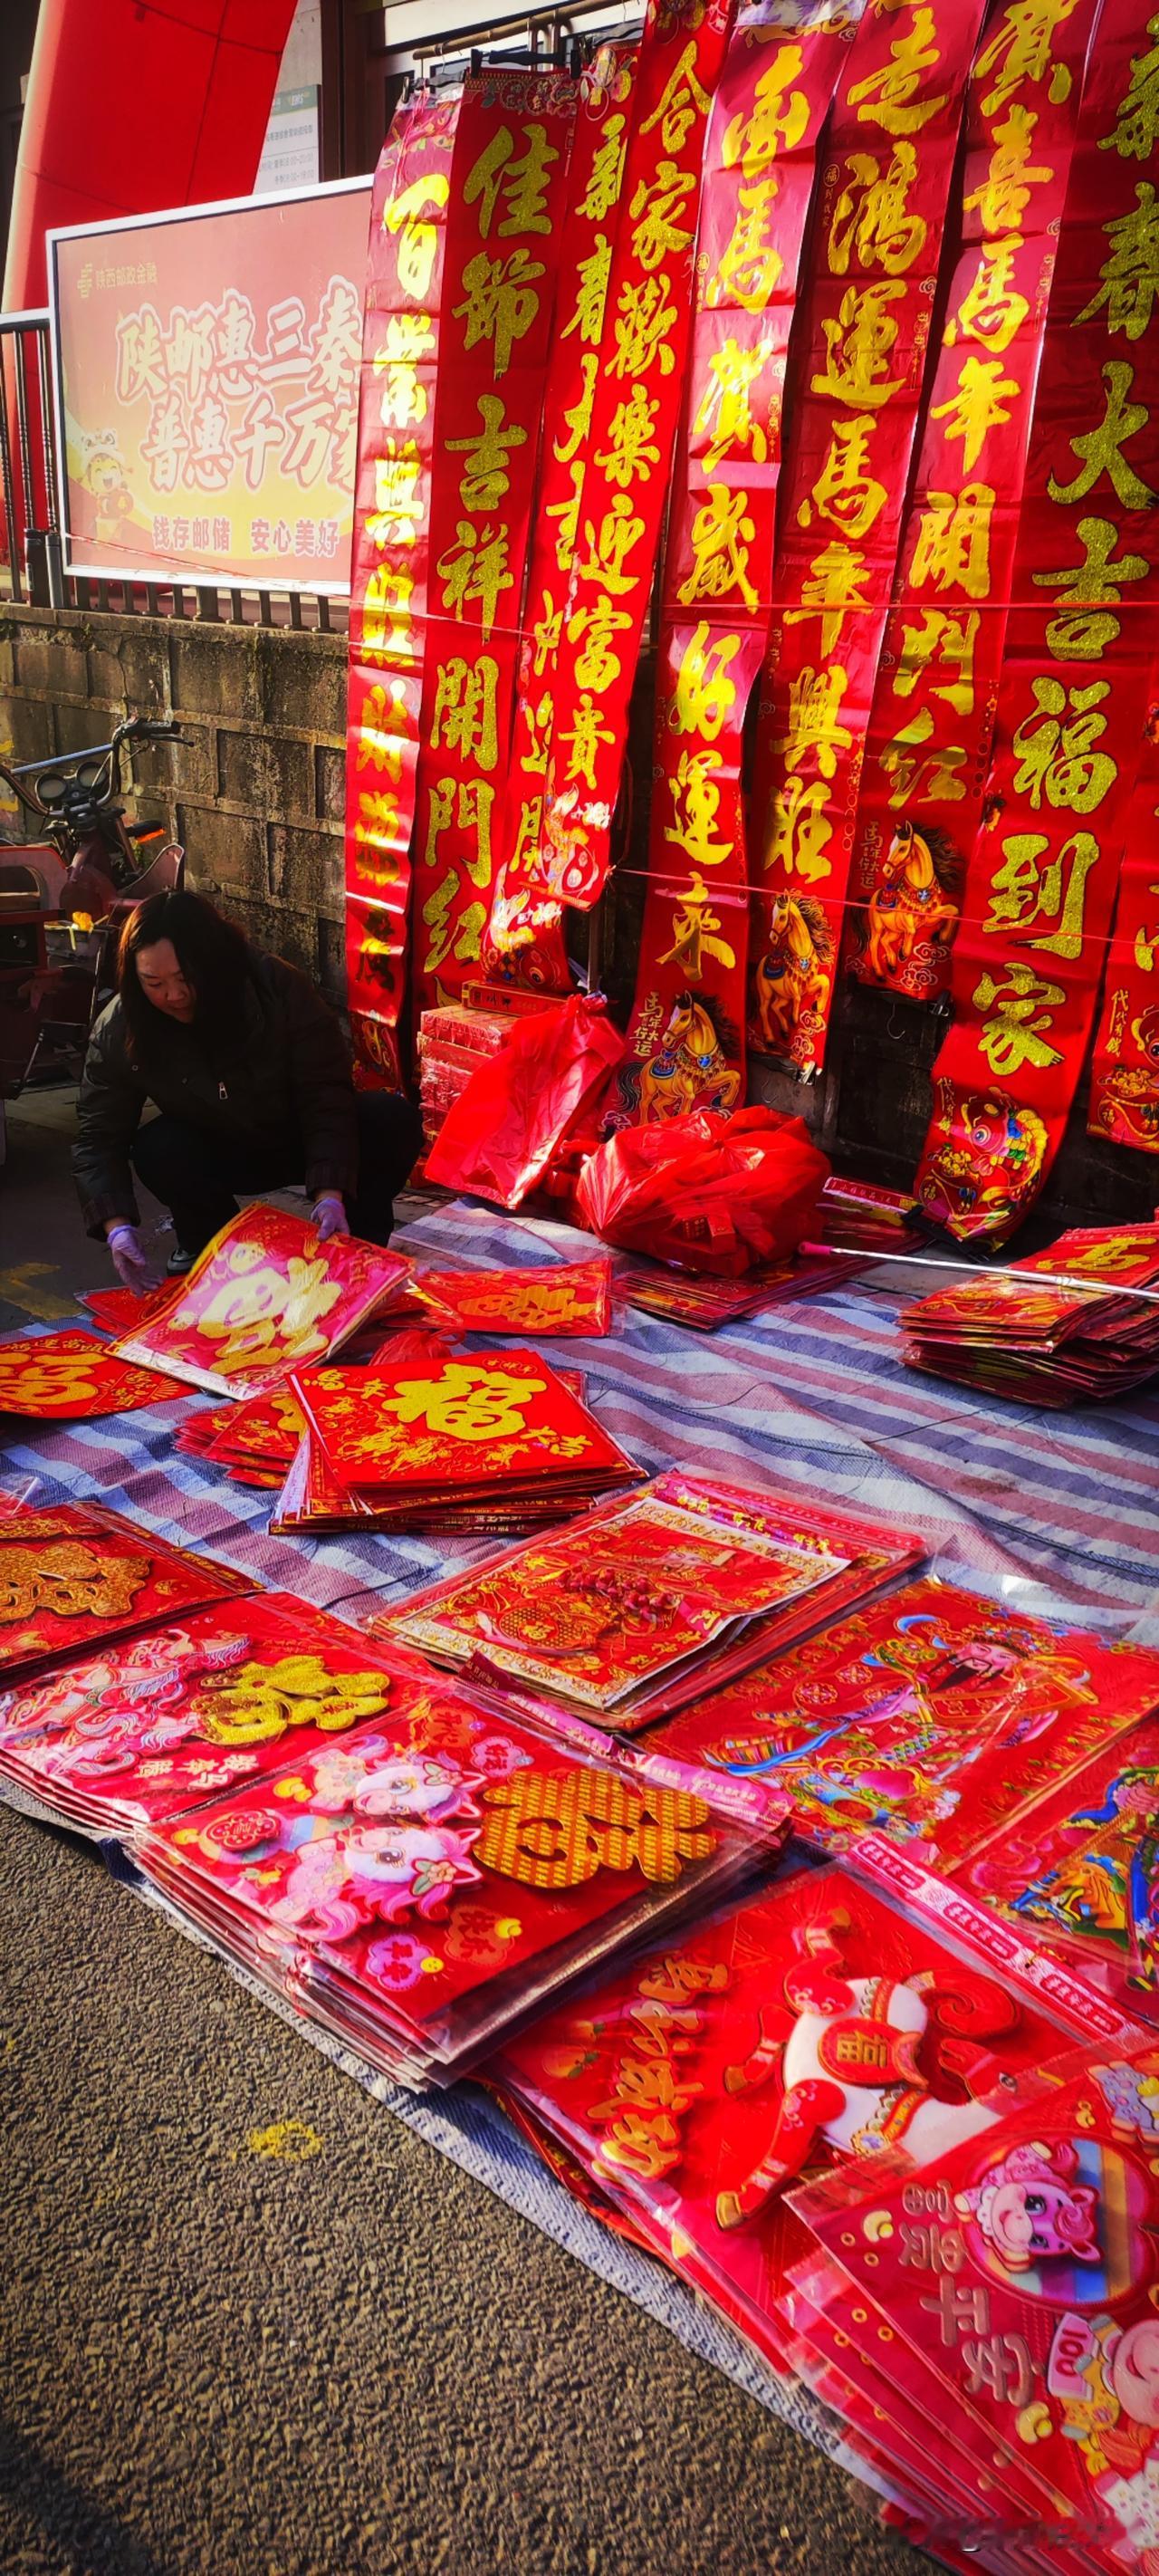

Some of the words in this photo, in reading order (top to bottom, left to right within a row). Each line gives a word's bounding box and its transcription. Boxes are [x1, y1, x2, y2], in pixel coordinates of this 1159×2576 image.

[118, 277, 362, 401] 陕邮惠三秦
[152, 516, 231, 552] 钱存邮储
[251, 519, 340, 557] 安心美好
[303, 1369, 390, 1399] 馬年
[381, 1363, 548, 1441] 福
[521, 1426, 593, 1458] 大吉
[473, 1768, 717, 1888] 福
[835, 2031, 889, 2068] 福
[899, 2178, 1045, 2408] 富贵平安
